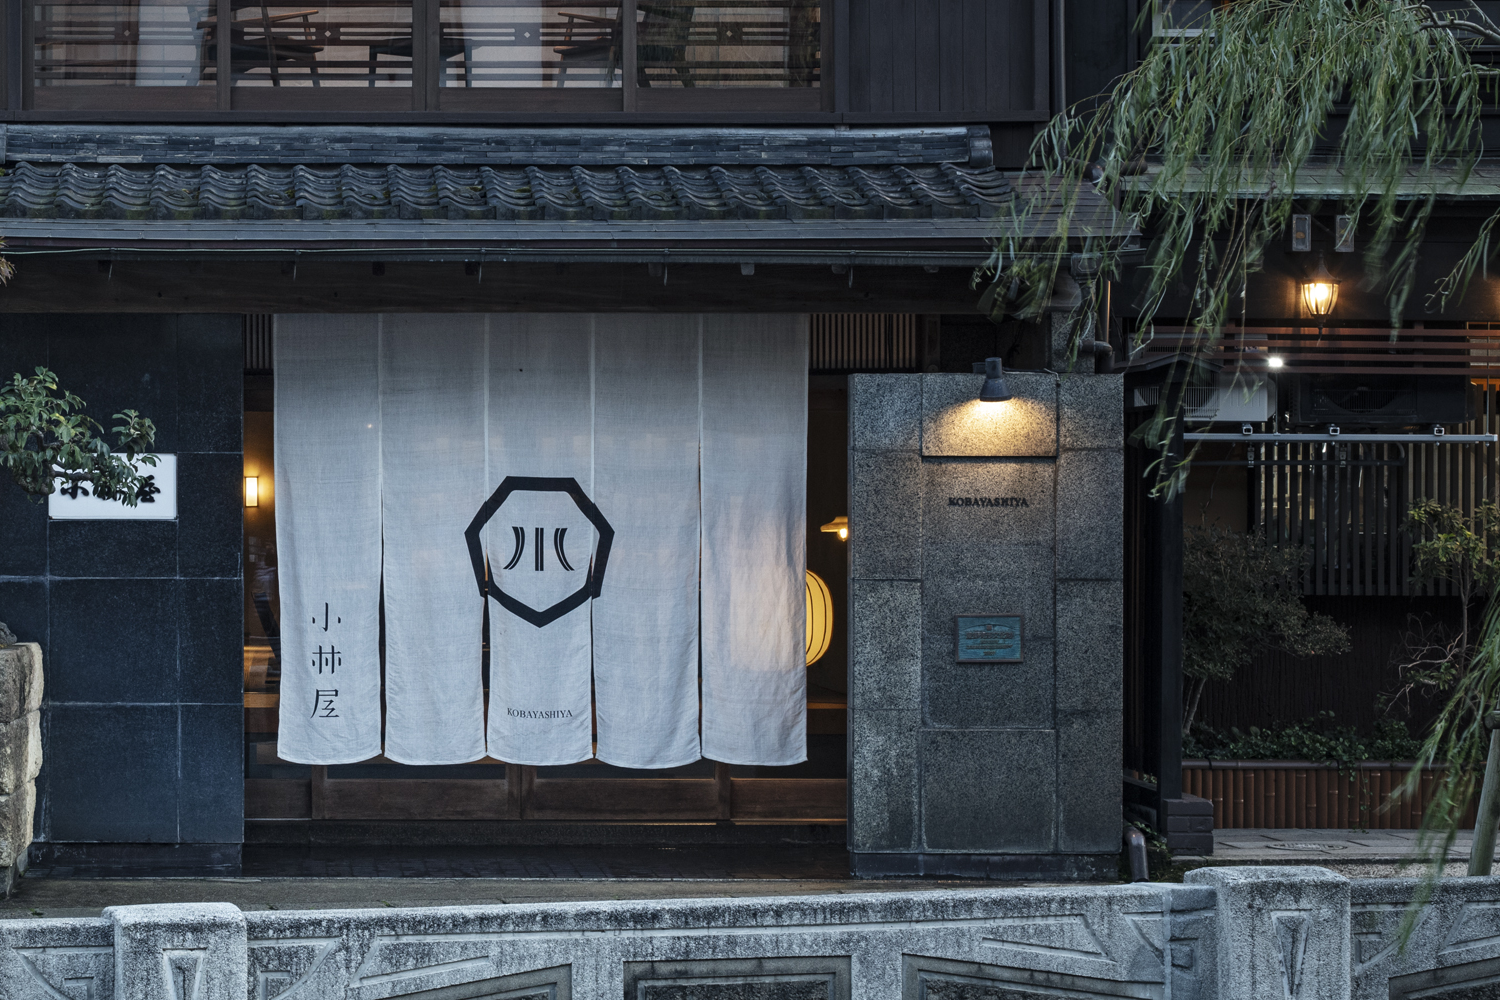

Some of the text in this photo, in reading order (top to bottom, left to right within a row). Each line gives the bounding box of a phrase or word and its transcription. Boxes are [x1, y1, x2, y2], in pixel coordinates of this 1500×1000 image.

[60, 473, 161, 503] 小屋
[947, 497, 1030, 508] KOBAYASHIYA
[310, 602, 342, 719] 小林屋
[507, 707, 573, 719] KOBAYASHIYA
